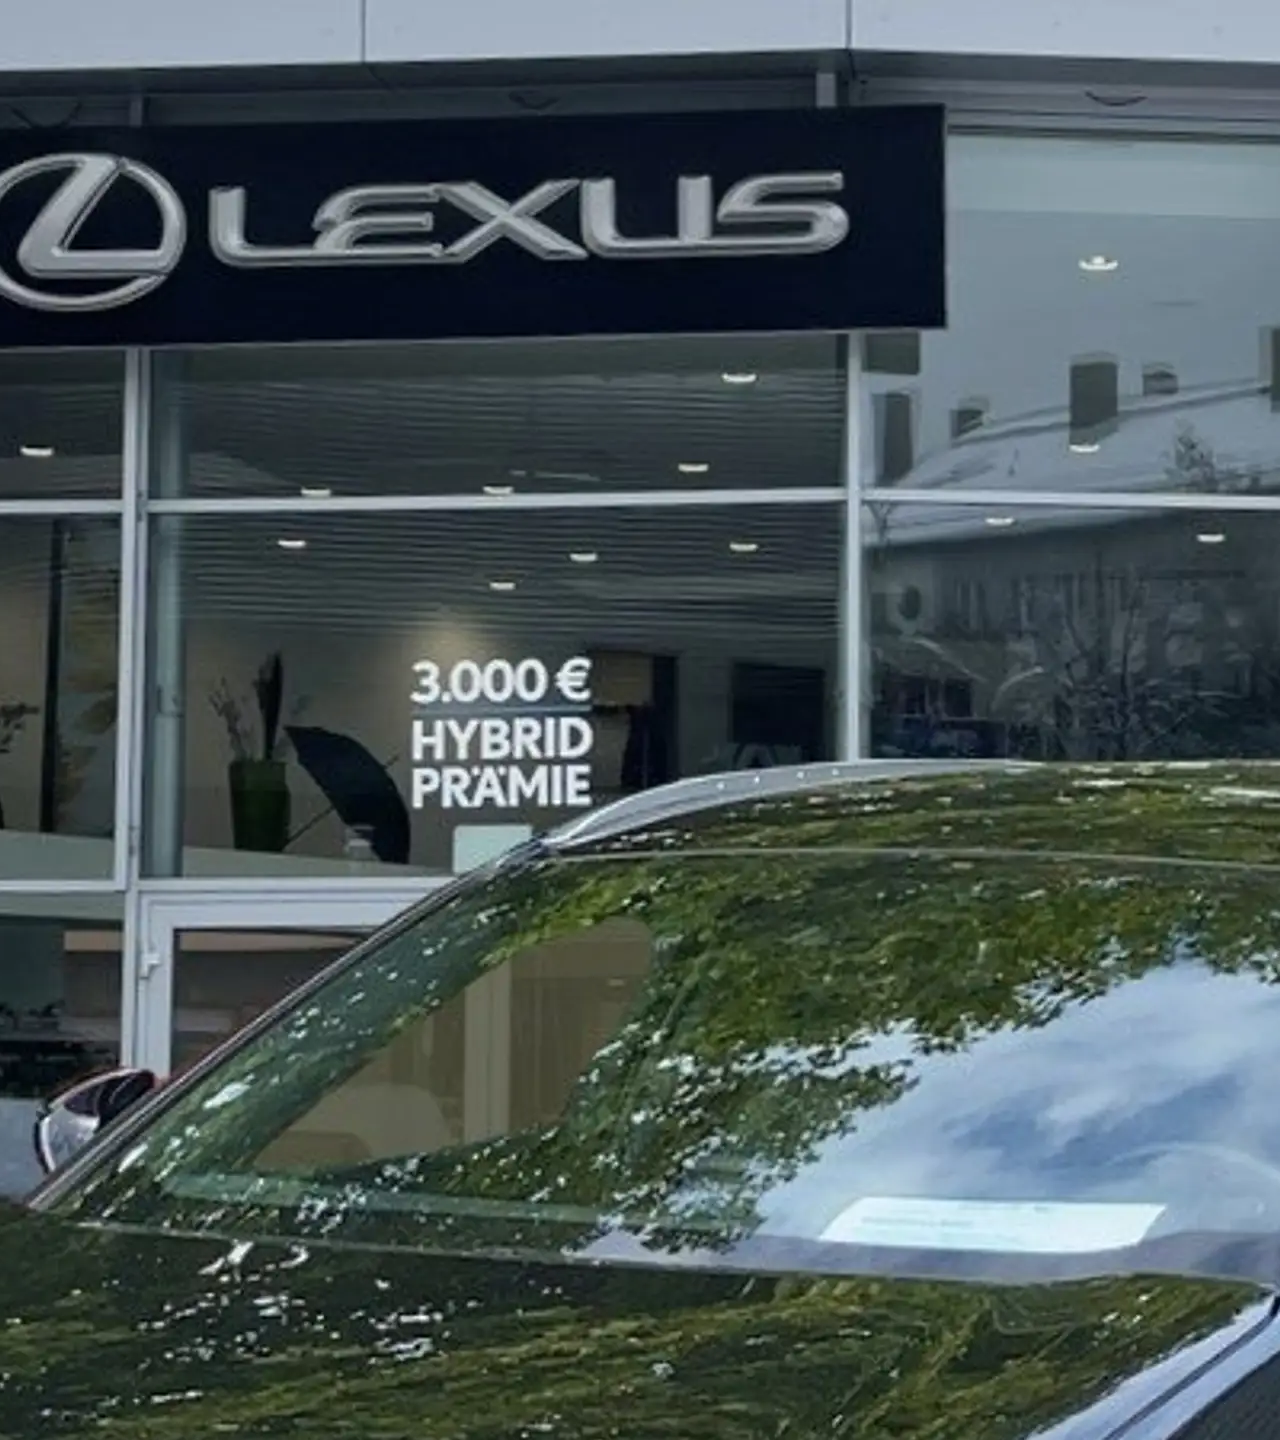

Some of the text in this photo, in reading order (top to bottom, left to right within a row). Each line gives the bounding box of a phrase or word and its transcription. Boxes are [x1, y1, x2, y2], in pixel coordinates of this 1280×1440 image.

[208, 171, 849, 267] LEXUS
[409, 656, 592, 704] 3.000 €
[412, 716, 594, 761] HYBRID
[412, 764, 592, 809] PRÄMIE
